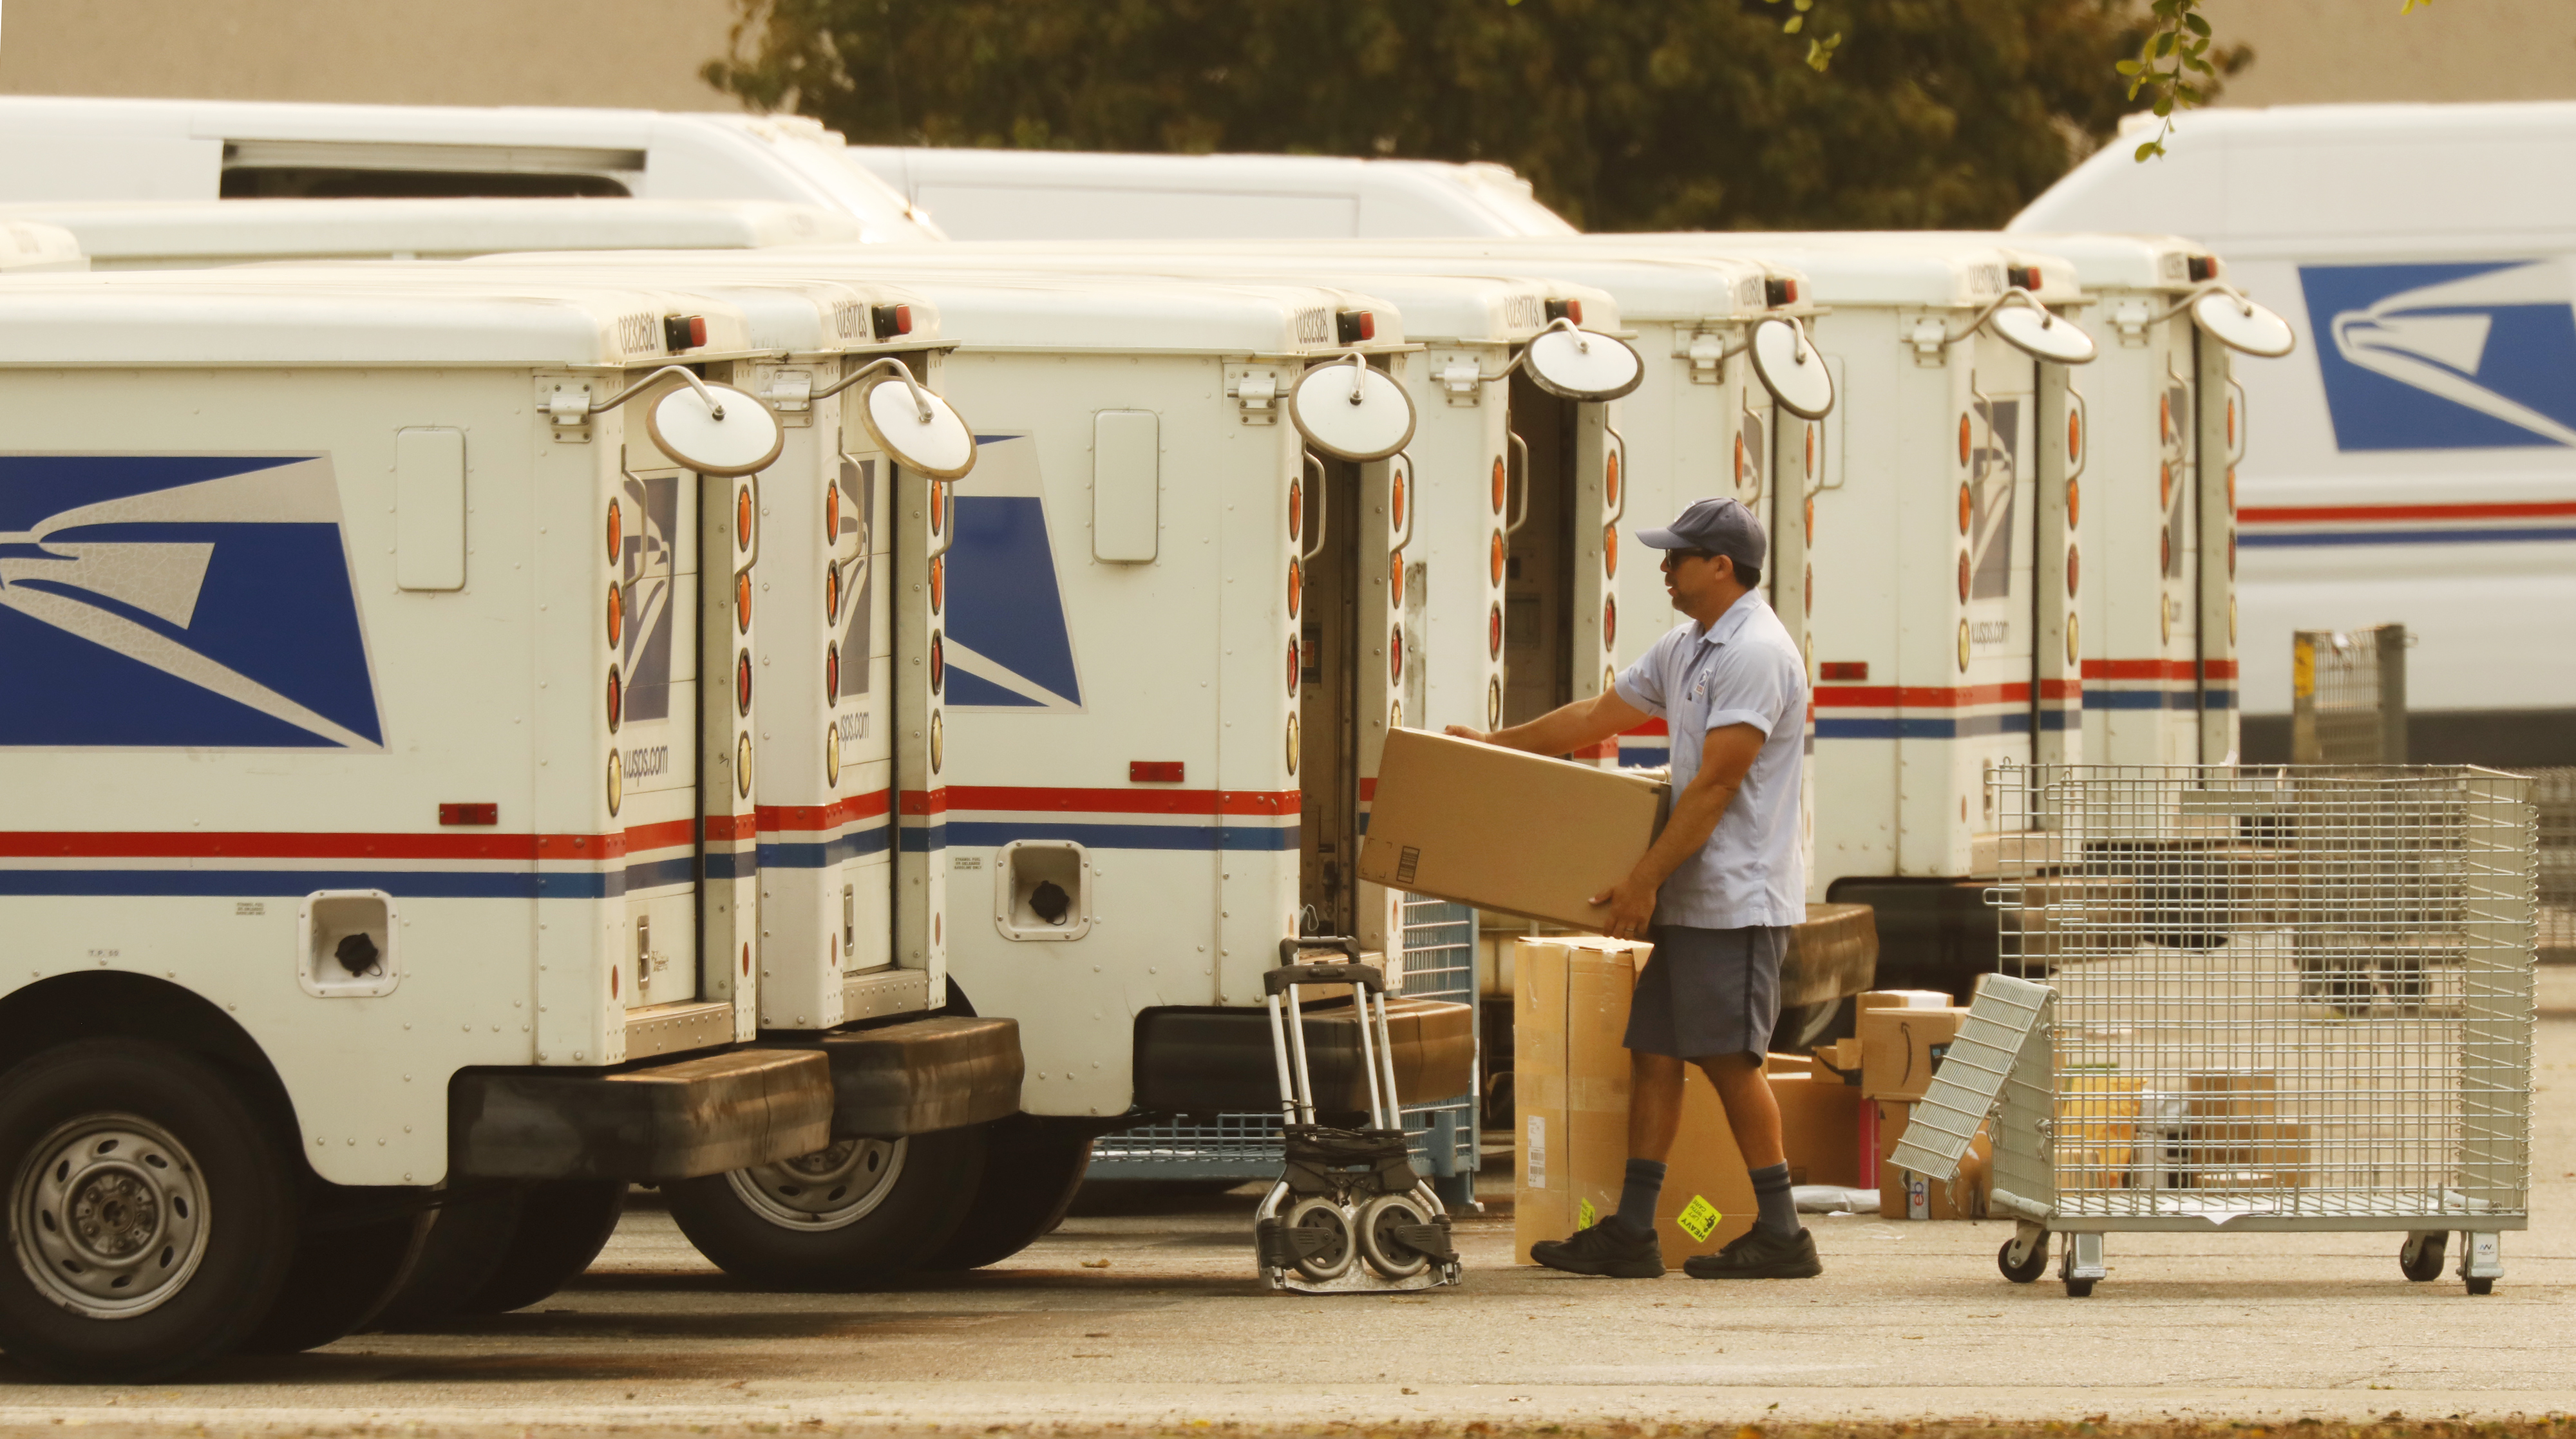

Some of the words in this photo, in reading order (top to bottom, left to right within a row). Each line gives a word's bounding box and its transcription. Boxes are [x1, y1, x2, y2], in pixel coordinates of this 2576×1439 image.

[832, 300, 867, 339] 0231723
[1294, 306, 1329, 344] 0232328
[1504, 294, 1539, 328] 0231773
[618, 310, 658, 355] 0232621
[1688, 1212, 1700, 1221] LIFT
[1690, 1205, 1703, 1217] WITH
[1692, 1199, 1707, 1212] CARE
[1681, 1218, 1705, 1240] HEAVY
